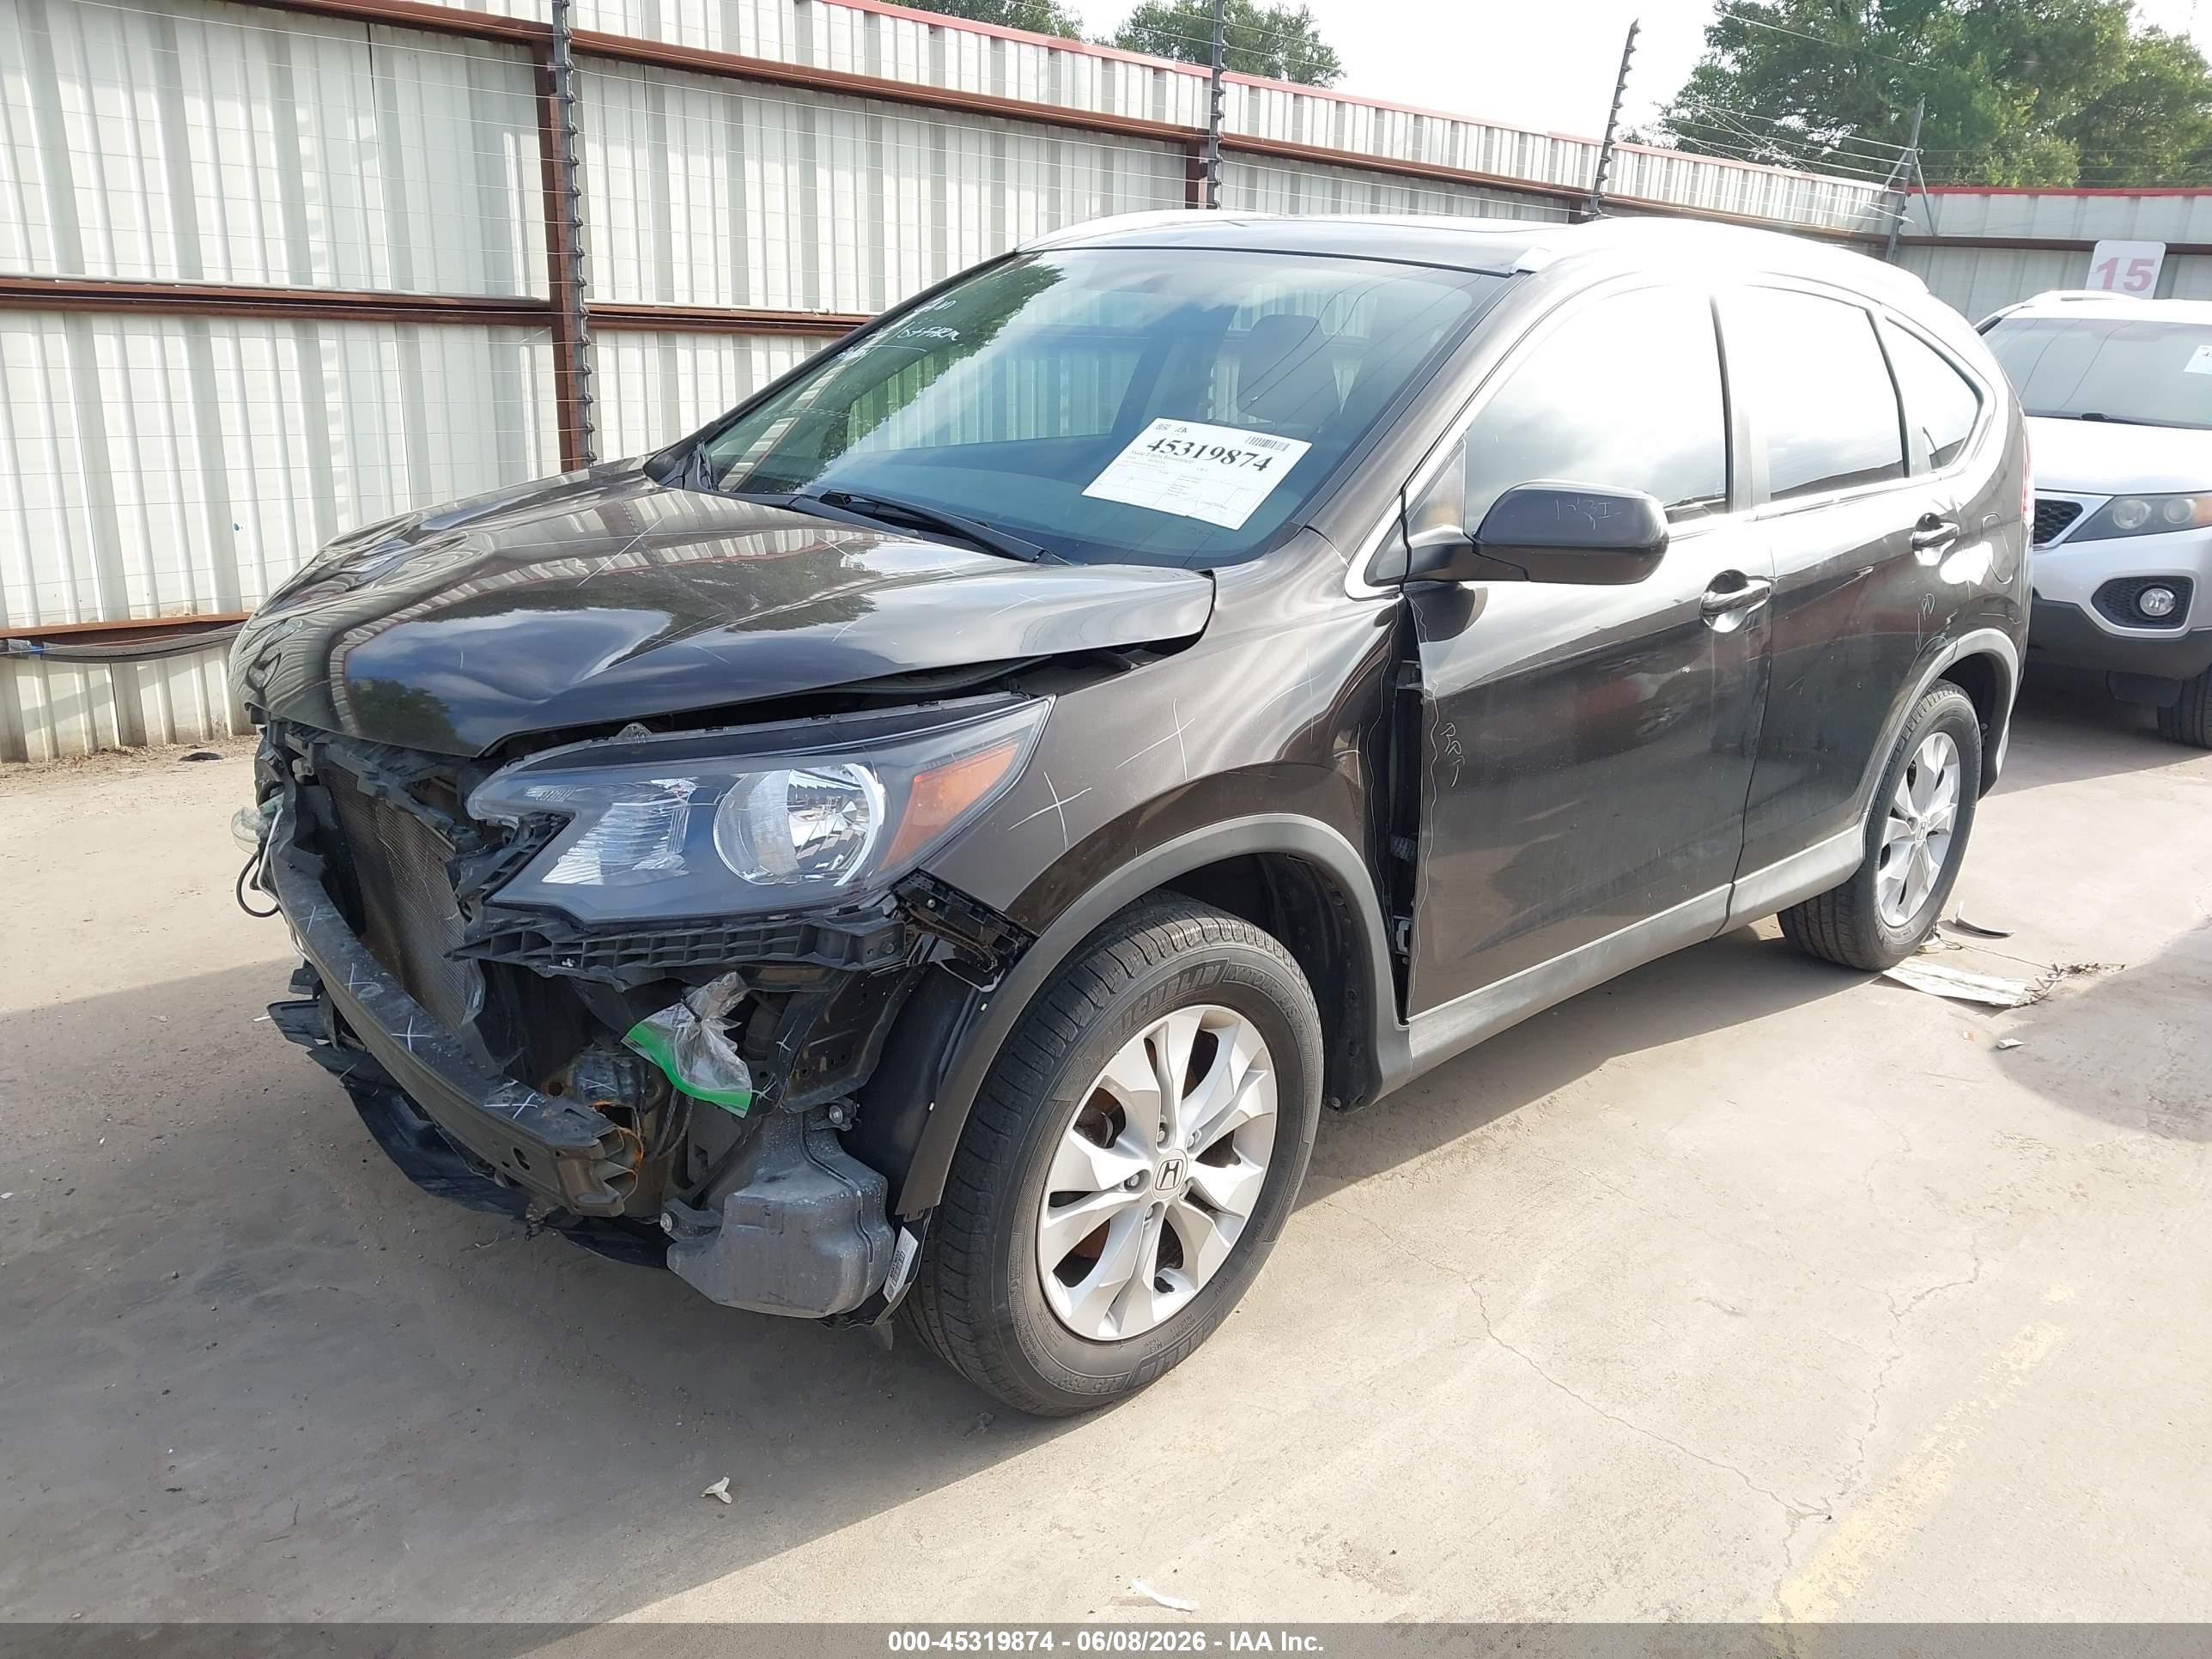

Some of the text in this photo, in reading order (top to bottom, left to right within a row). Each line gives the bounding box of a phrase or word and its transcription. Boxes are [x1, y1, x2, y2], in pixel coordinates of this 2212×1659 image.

[2096, 258, 2155, 292] 15
[1147, 438, 1273, 471] 45319874
[1099, 965, 1220, 1051] MICHELIN
